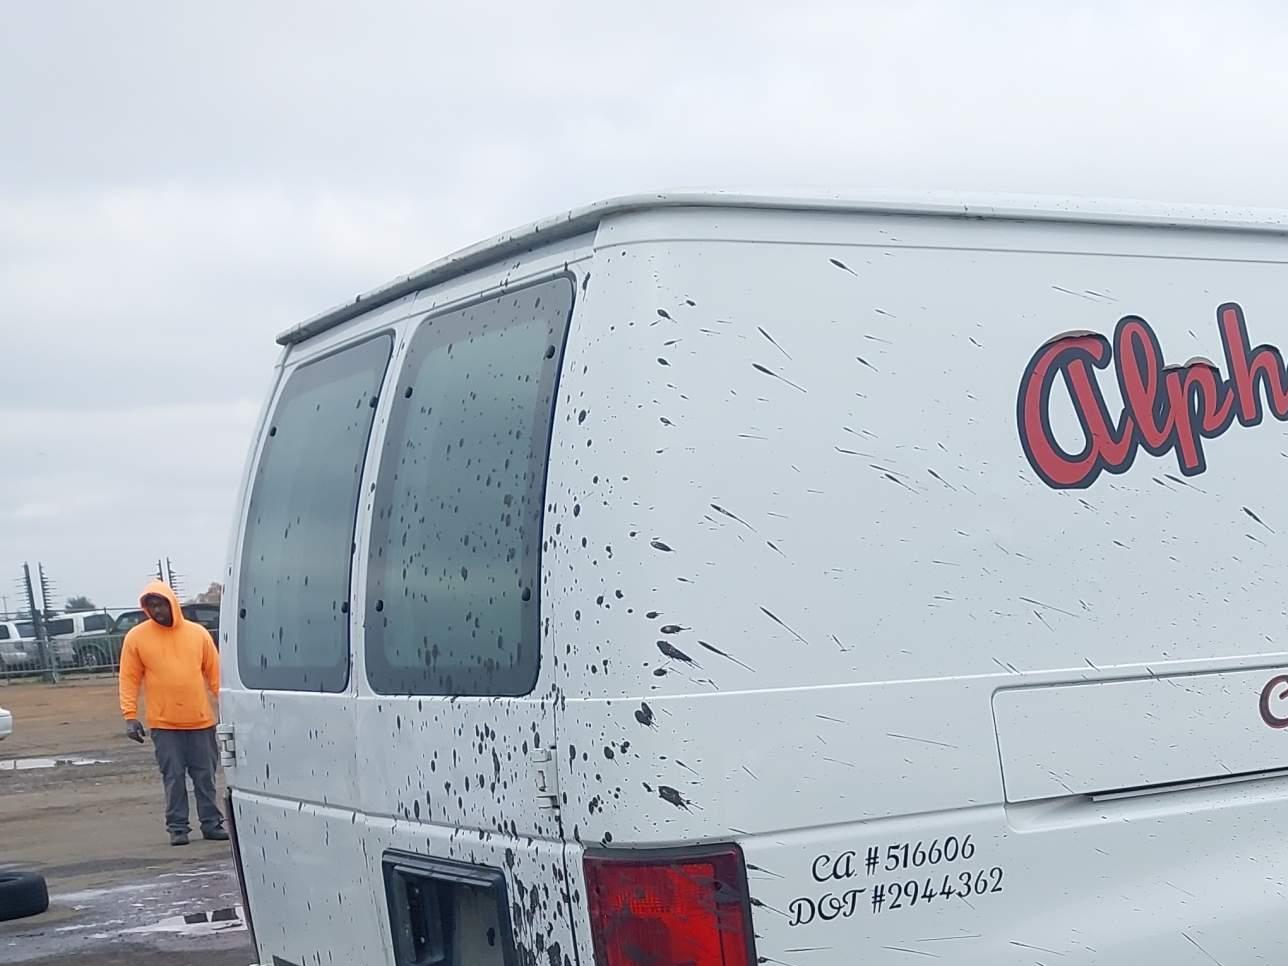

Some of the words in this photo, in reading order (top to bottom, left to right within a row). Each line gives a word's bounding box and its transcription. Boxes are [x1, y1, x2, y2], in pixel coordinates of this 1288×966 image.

[865, 834, 975, 876] #516606
[788, 887, 867, 927] DOT
[871, 866, 1004, 914] #2944362
